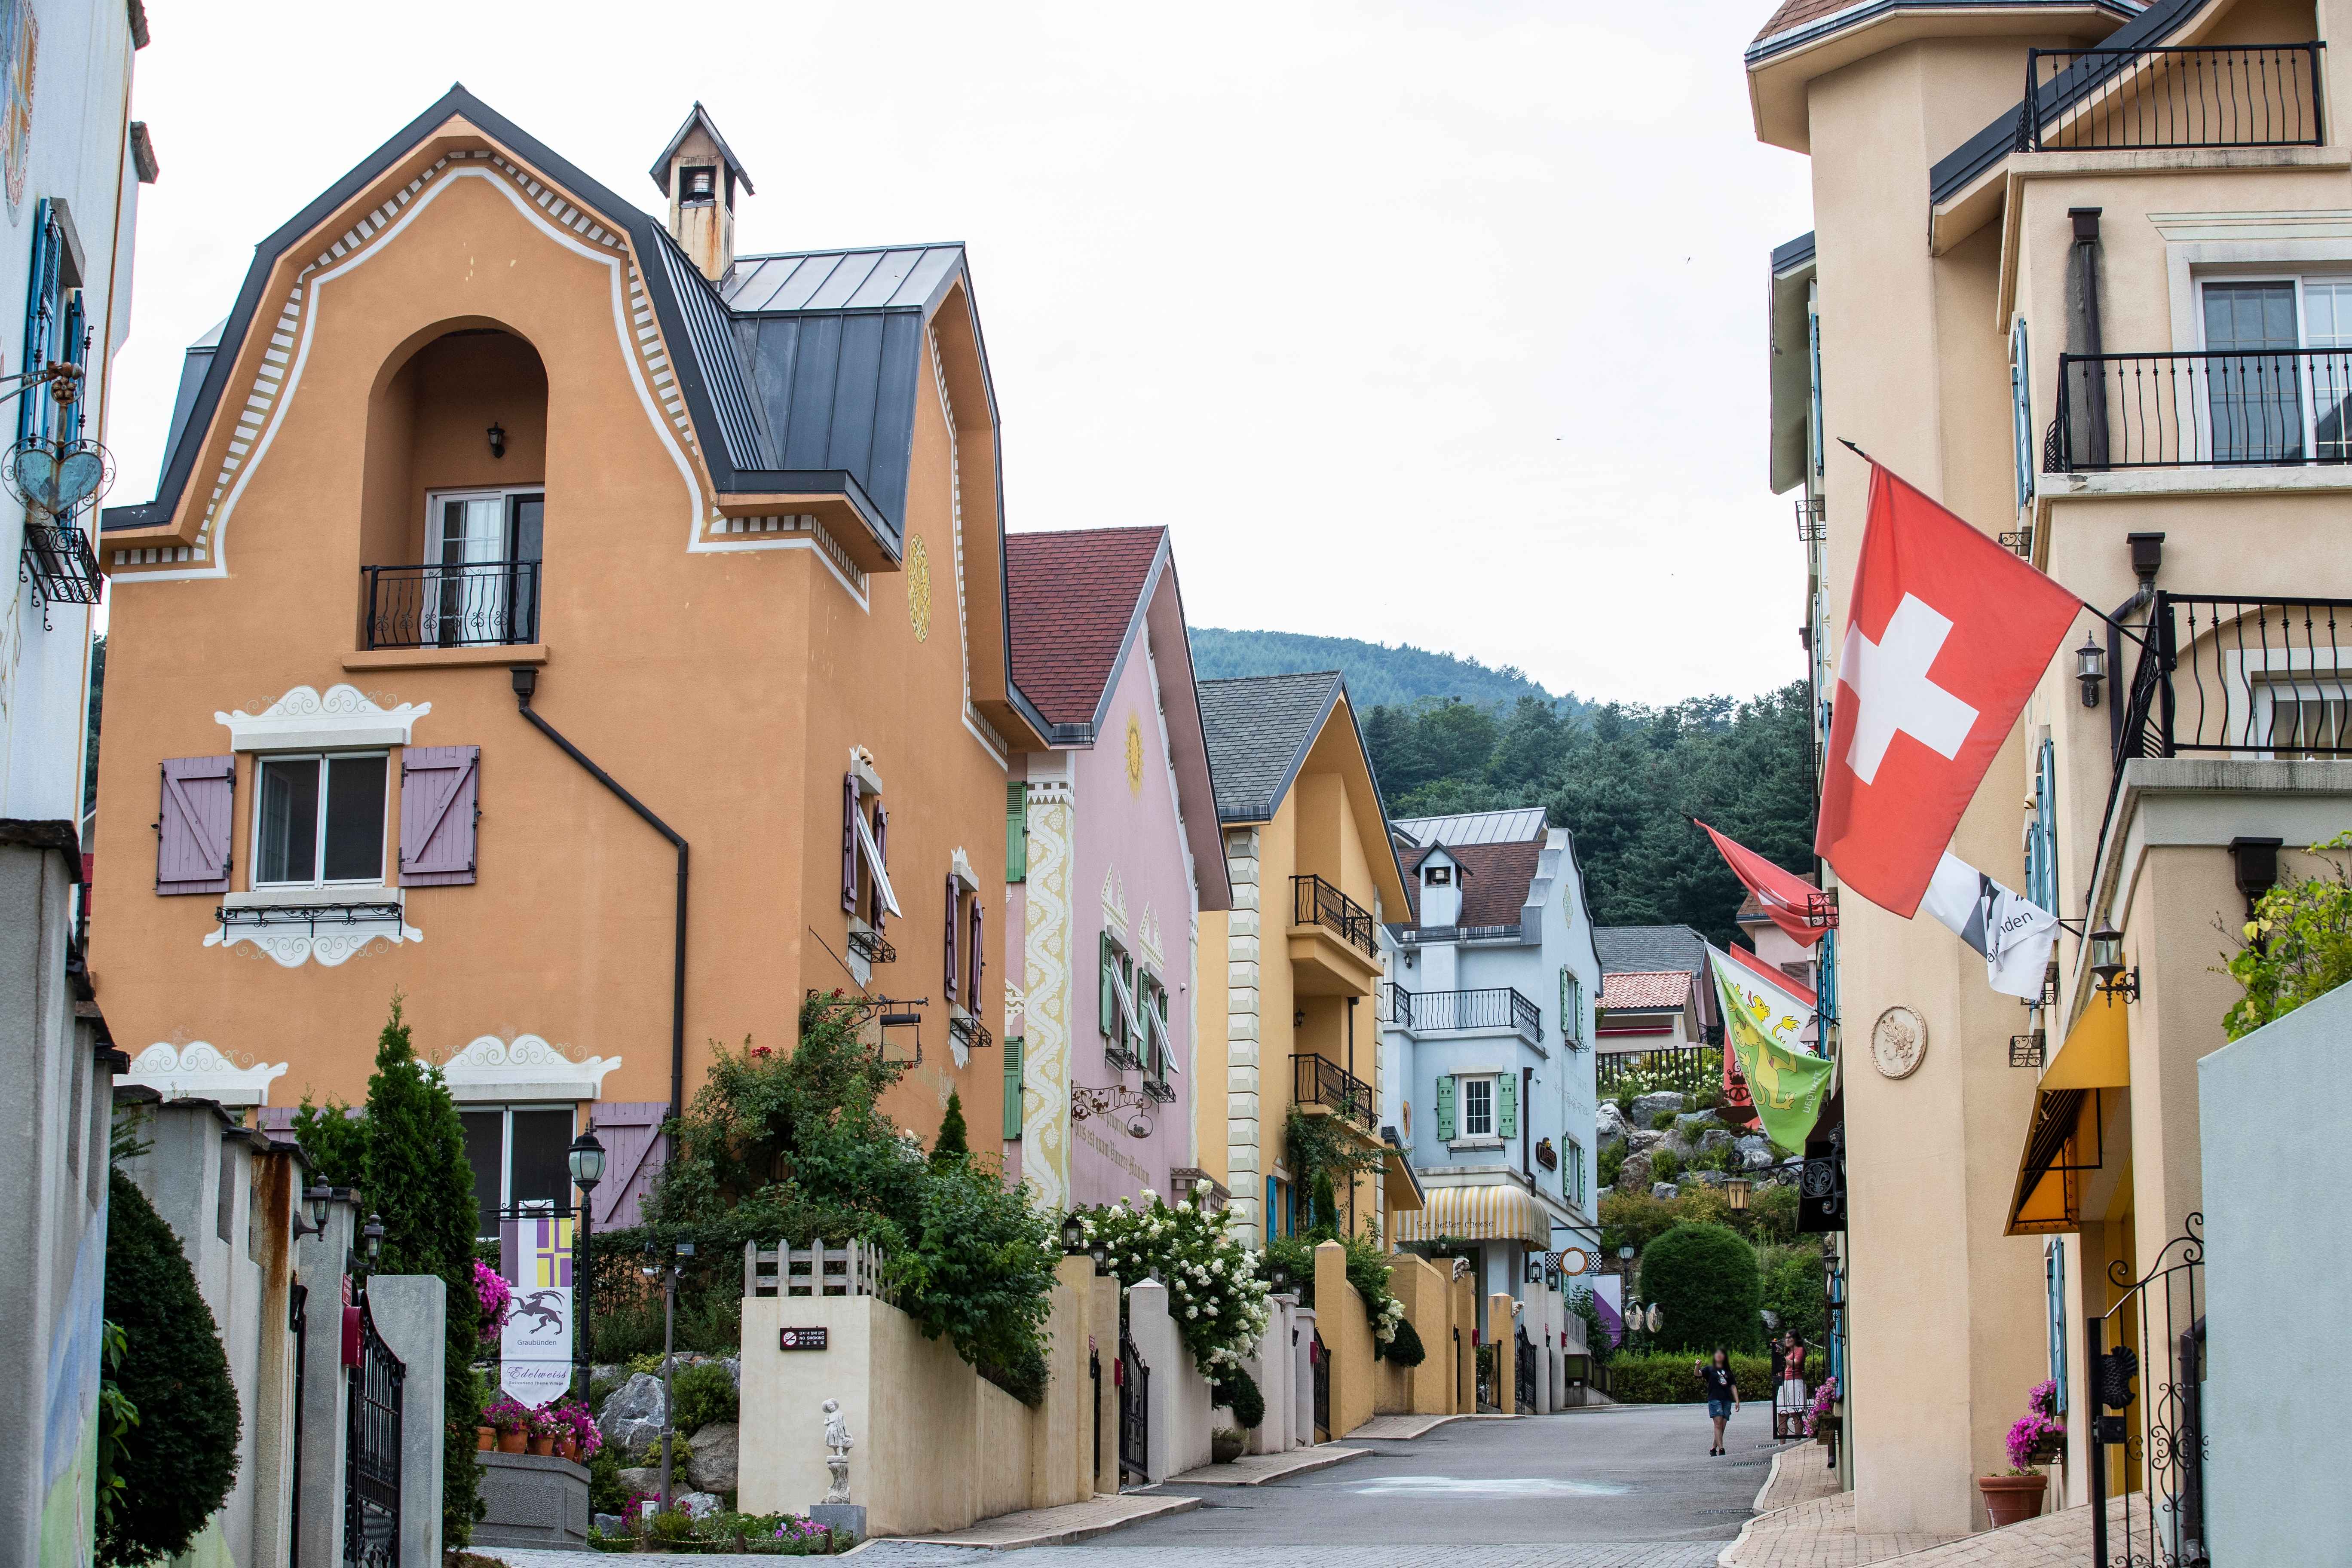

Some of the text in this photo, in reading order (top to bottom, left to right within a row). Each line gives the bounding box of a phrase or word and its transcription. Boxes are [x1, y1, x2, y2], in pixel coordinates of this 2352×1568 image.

[1096, 1136, 1109, 1158] quam
[1417, 1218, 1494, 1230] Eat better cheese
[507, 1366, 567, 1379] Edelweiss
